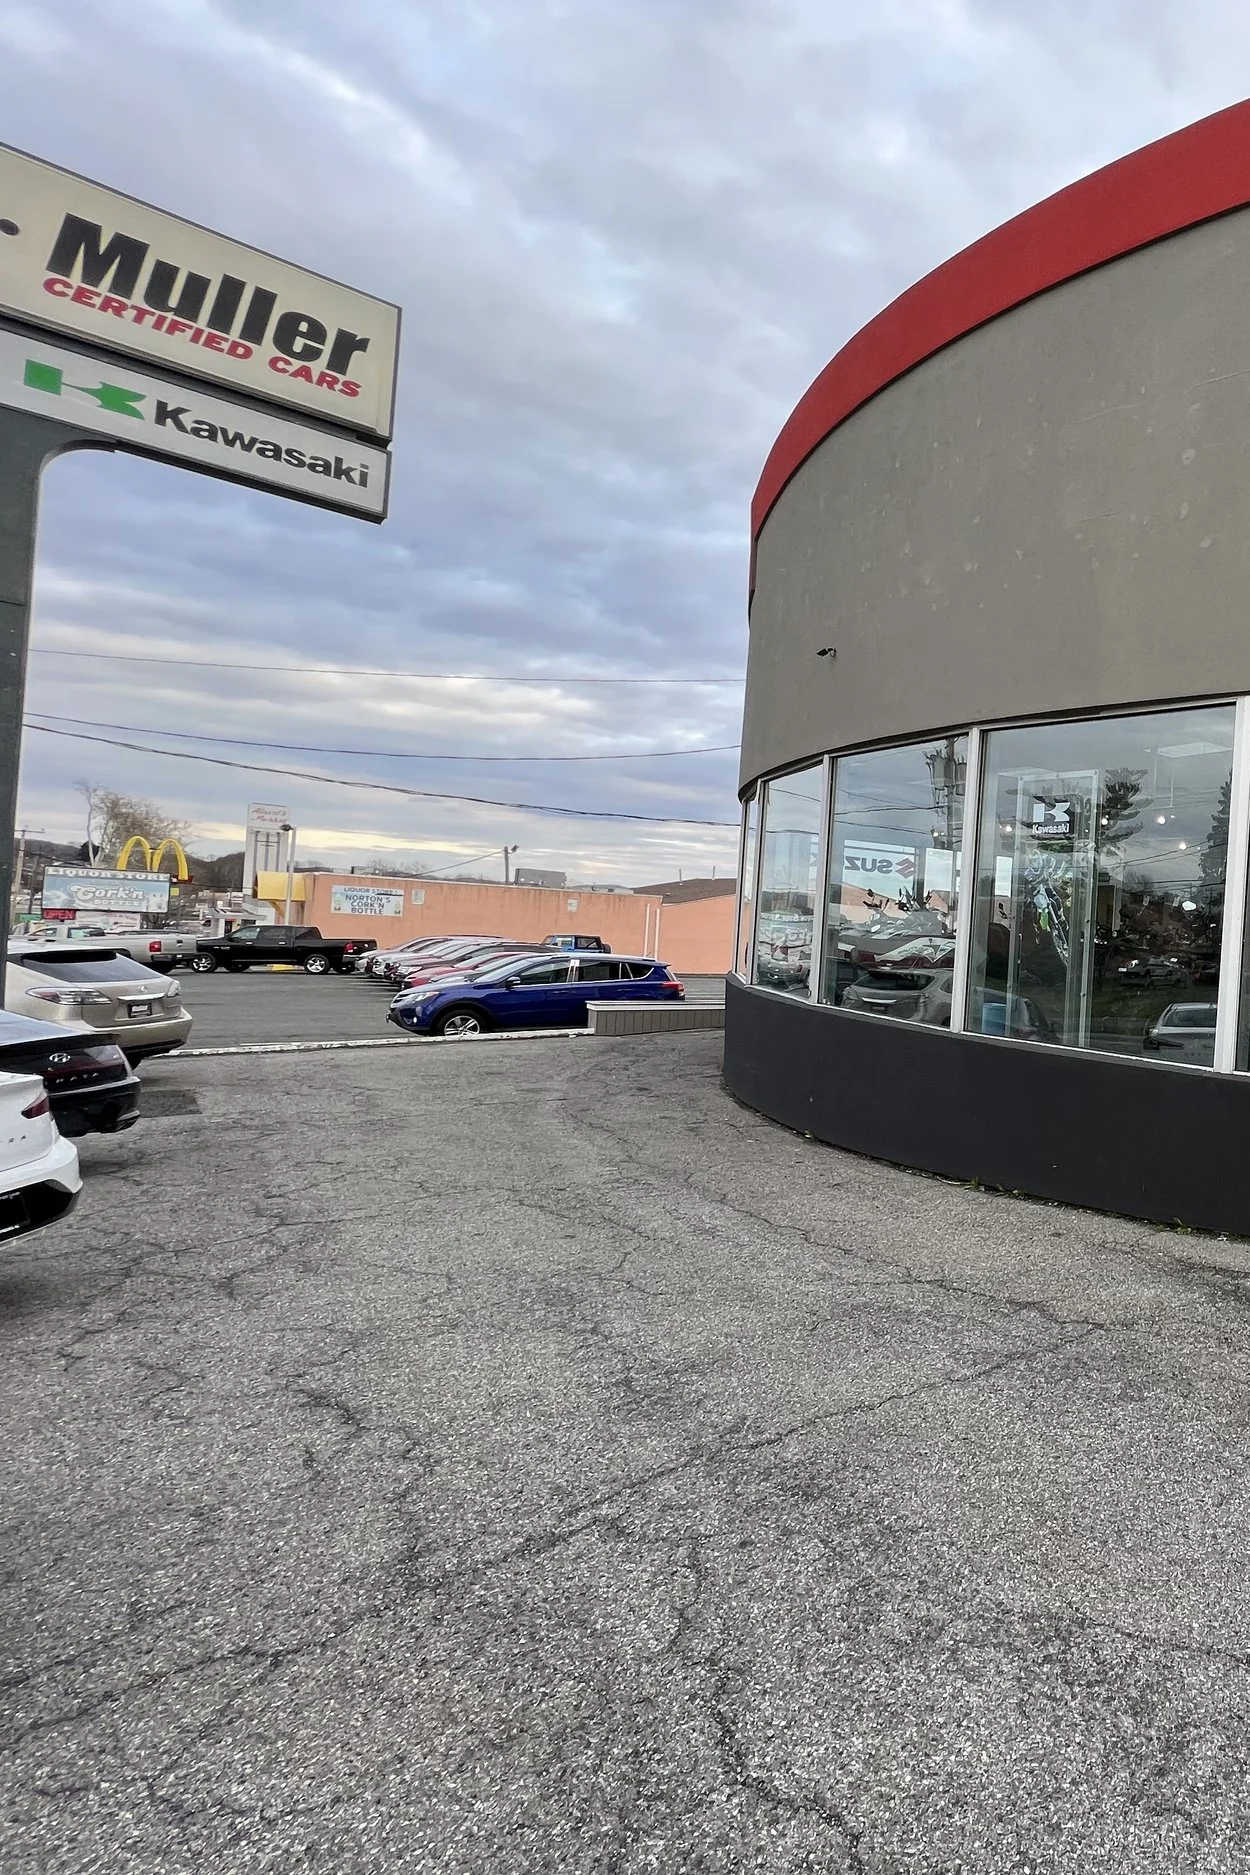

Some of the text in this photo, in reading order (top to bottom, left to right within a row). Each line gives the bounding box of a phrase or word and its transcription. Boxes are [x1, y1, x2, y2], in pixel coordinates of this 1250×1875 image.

[46, 212, 370, 376] Muller
[43, 277, 362, 397] CERTIFIED CARS
[154, 400, 368, 488] Kawasaki
[1032, 823, 1069, 834] Kawasaki
[47, 867, 169, 881] LIQUOR STORE
[345, 894, 391, 904] NORTON'S
[351, 907, 384, 915] BOTTLE
